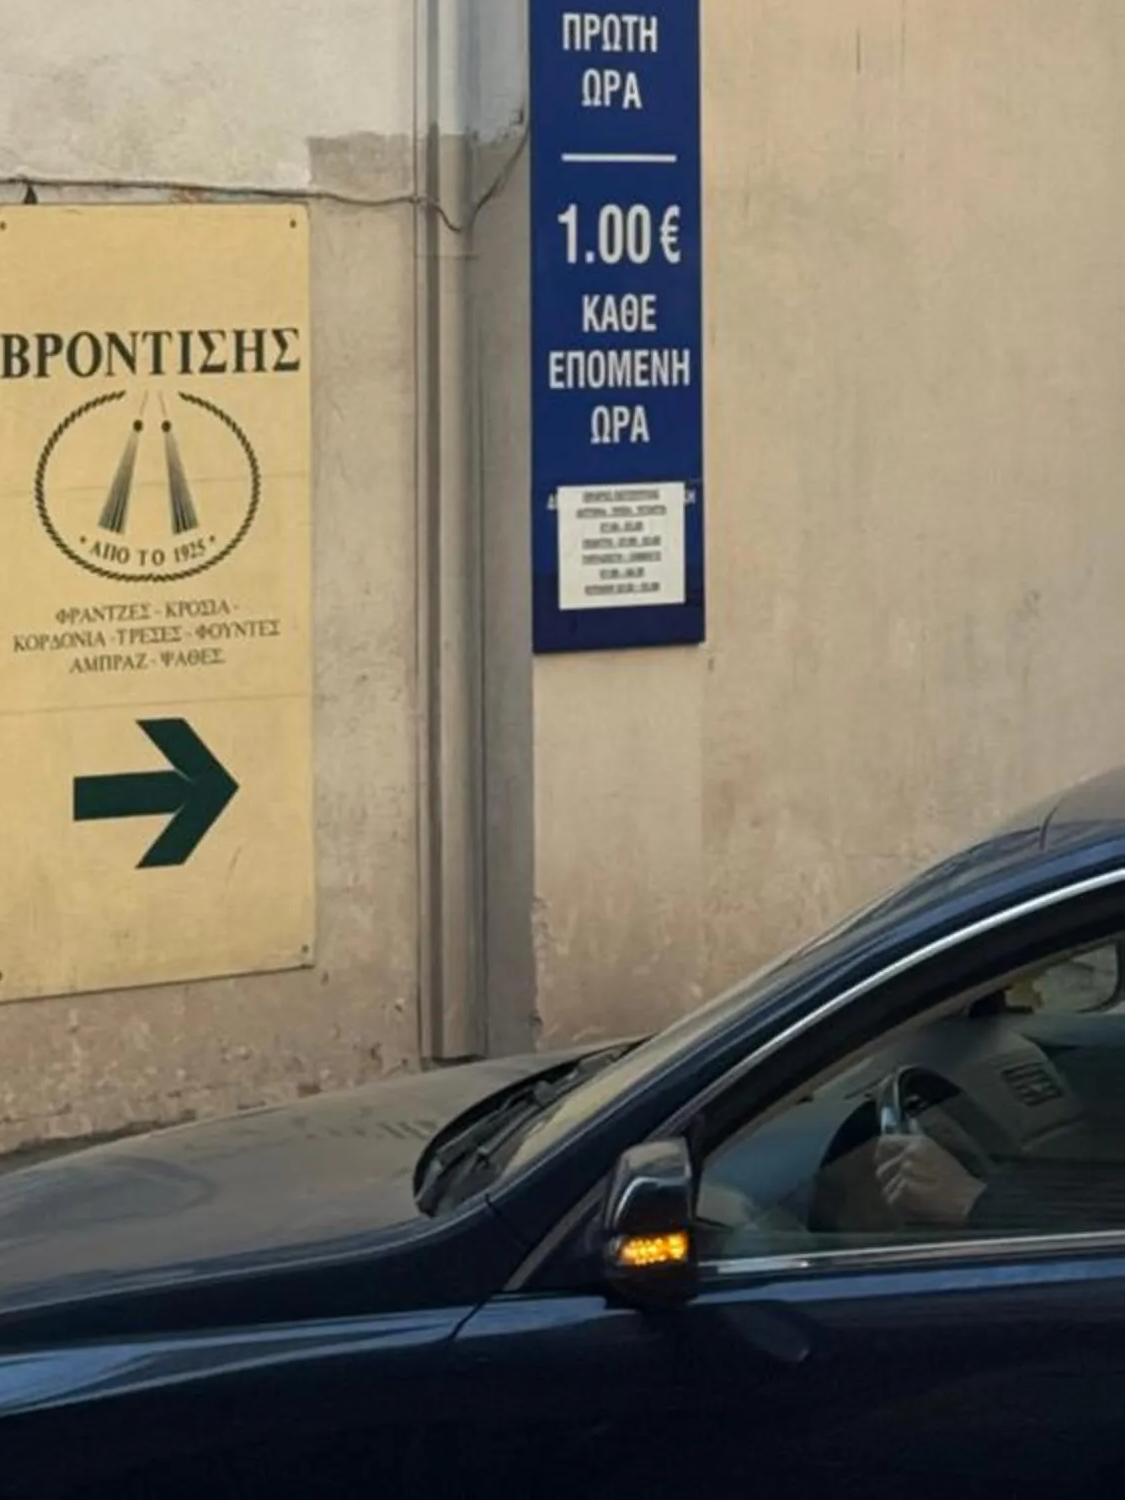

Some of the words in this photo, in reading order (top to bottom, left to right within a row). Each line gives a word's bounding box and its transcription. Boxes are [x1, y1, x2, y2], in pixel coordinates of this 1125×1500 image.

[562, 12, 658, 53] ΠΡΩΤΗ
[582, 68, 642, 109] ΩΡΑ
[582, 293, 657, 332] ΚΑΘΕ
[0, 327, 301, 380] ΒΡΟΝΤΙΣΗΣ
[548, 348, 690, 389] ΕΠΟΜΕΝΗ
[590, 405, 650, 444] ΩΡΑ
[89, 540, 130, 565] ΑΠΟ
[137, 547, 165, 567] ΤΟ
[174, 538, 206, 563] 1925
[55, 602, 152, 625] ΦΡΑΝΤΖΕΣ
[165, 598, 231, 618] ΚΡΟΣΙΑ
[13, 631, 106, 652] ΚΟΡΔΟΝΙΑ
[195, 619, 280, 640] ΦΟΥΝΤΕΣ
[69, 652, 148, 674] ΑΜΠΡΑΖ
[160, 647, 226, 668] ΨΑΘΕΣ
